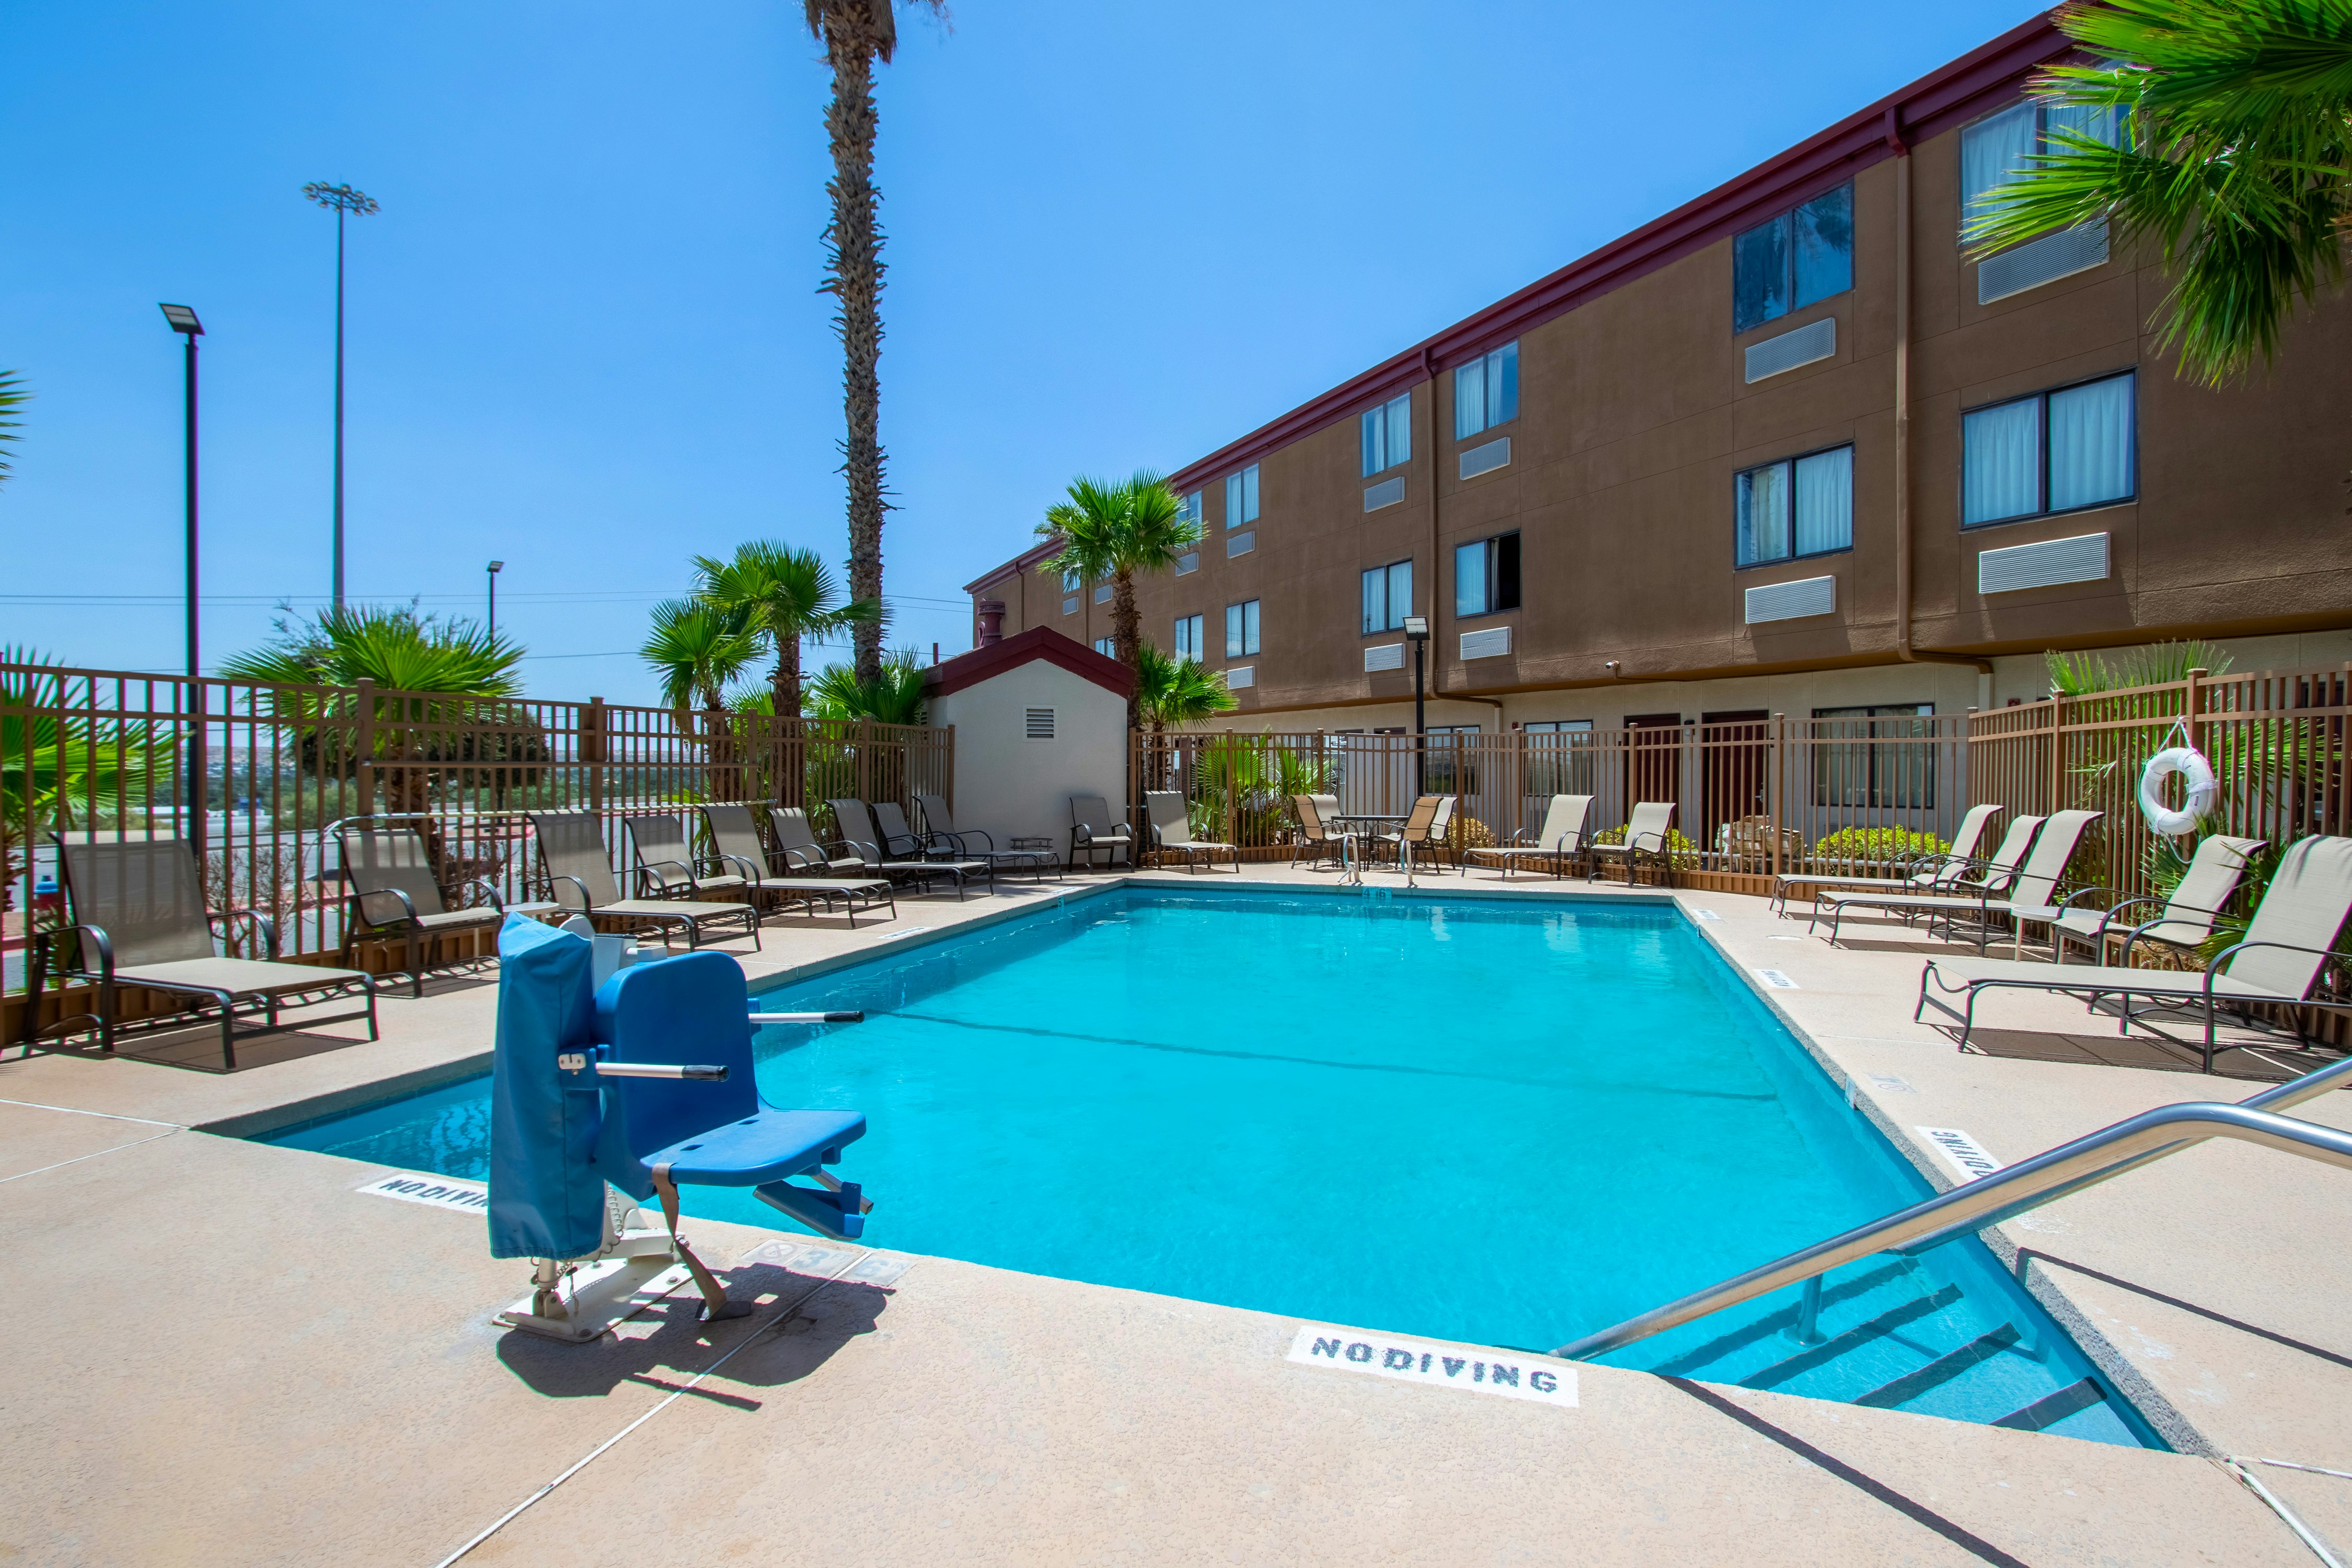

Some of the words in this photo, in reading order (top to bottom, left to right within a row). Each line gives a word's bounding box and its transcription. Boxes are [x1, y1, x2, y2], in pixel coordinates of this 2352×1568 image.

[1379, 888, 1386, 896] 6
[378, 1179, 427, 1194] NO
[792, 1250, 830, 1268] 3
[854, 1259, 889, 1277] 6
